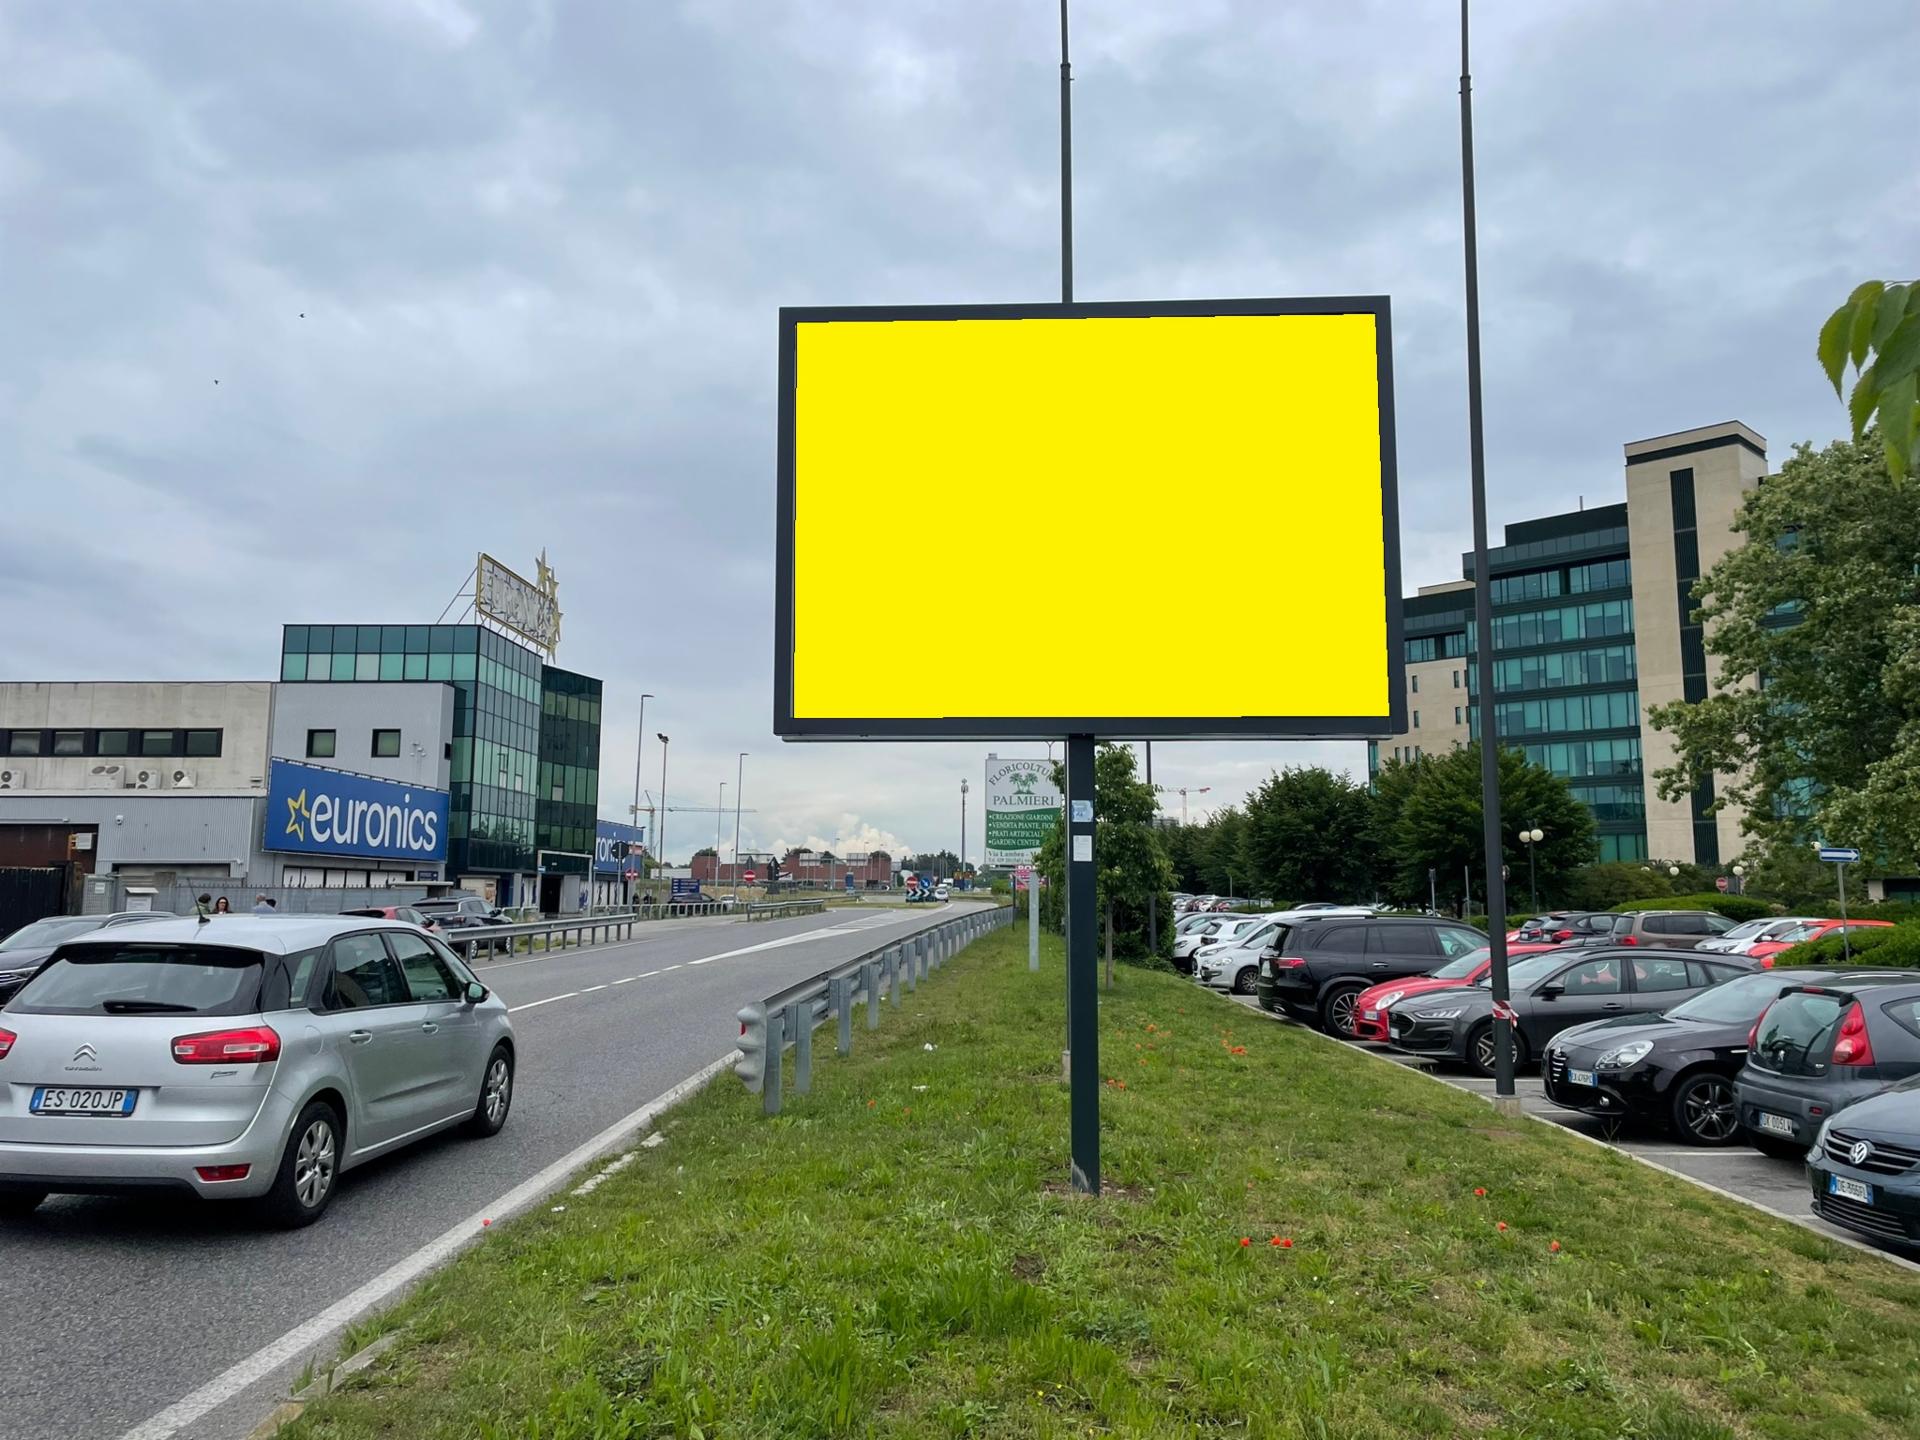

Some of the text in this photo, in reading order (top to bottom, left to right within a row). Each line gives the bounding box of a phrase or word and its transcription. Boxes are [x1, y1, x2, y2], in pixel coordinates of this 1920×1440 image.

[993, 795, 1054, 806] PALMIERI
[310, 793, 438, 851] euronics
[991, 813, 1024, 821] CREAZIONE
[991, 838, 1016, 846] GARDEN
[43, 1090, 123, 1109] ES 020JP
